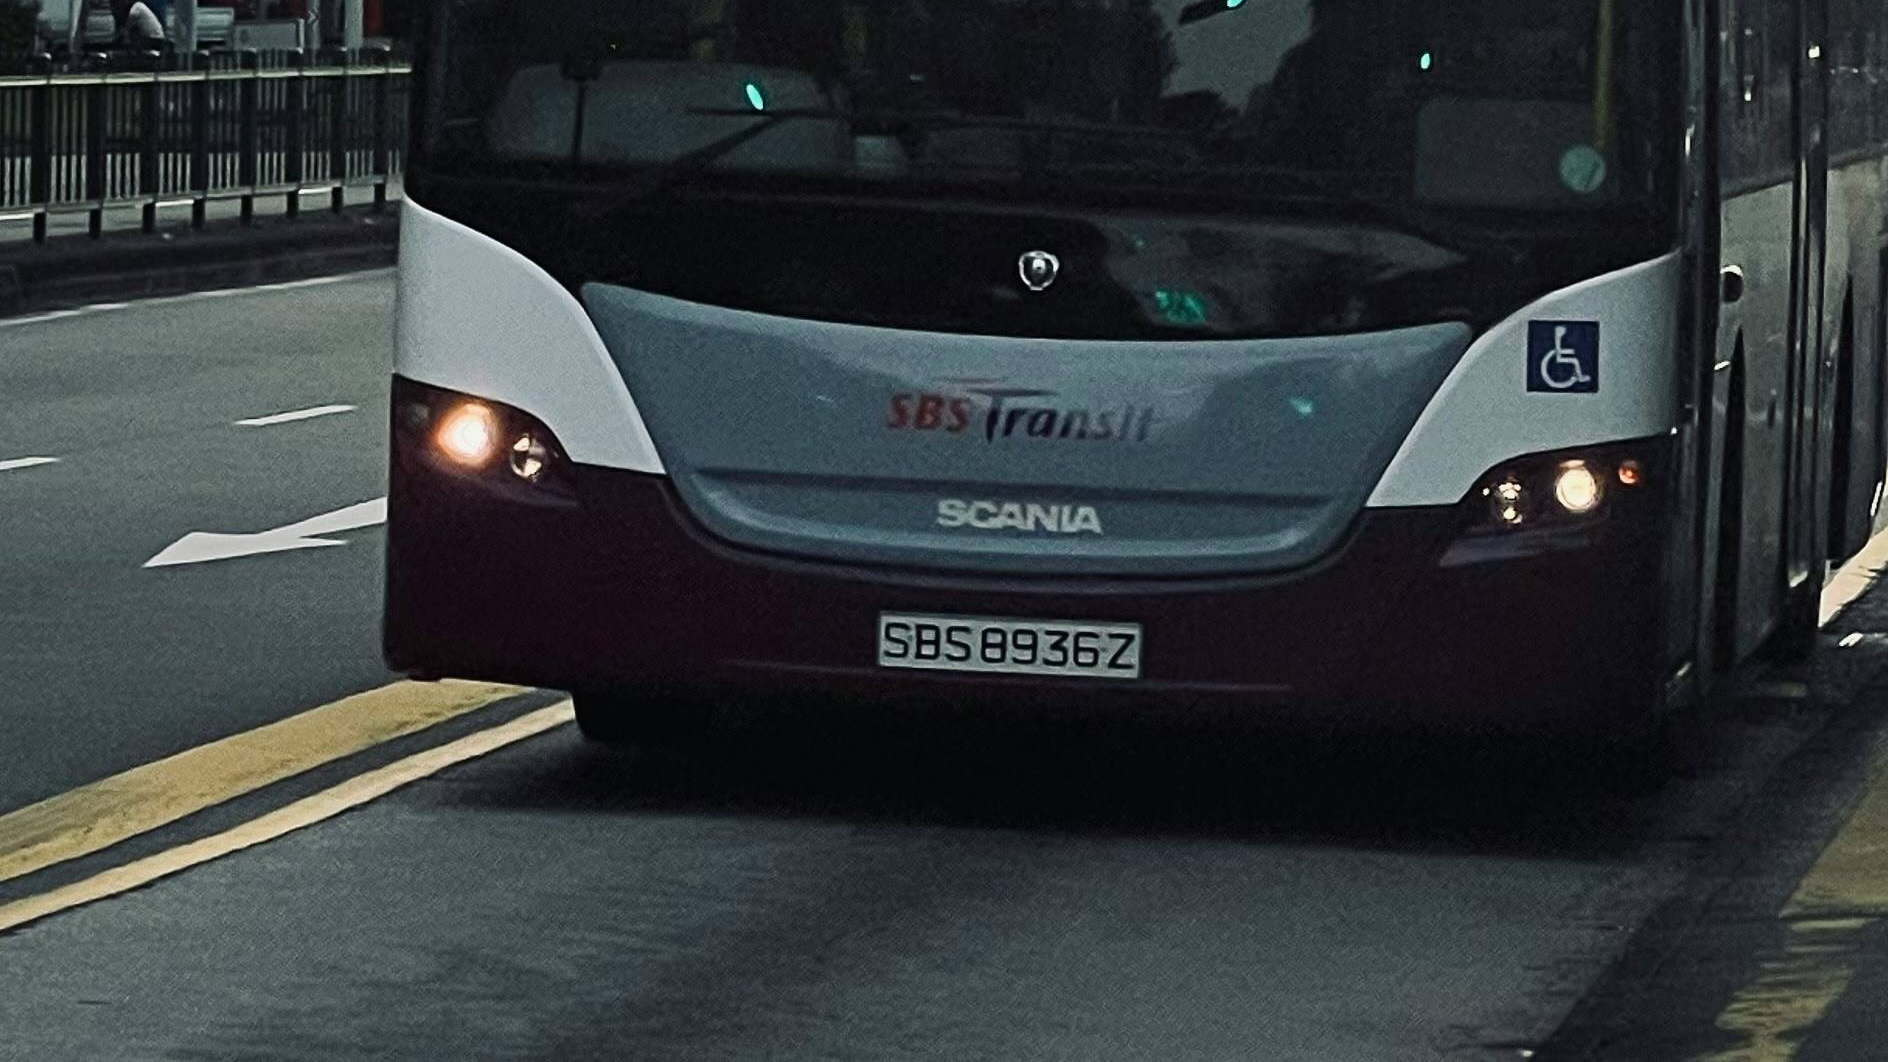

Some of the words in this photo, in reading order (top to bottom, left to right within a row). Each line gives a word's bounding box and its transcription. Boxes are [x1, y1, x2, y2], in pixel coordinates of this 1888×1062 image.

[887, 391, 970, 434] SBS
[968, 386, 1157, 444] Transit
[936, 498, 1104, 536] SCANIA
[883, 620, 1137, 671] SBS8936Z
